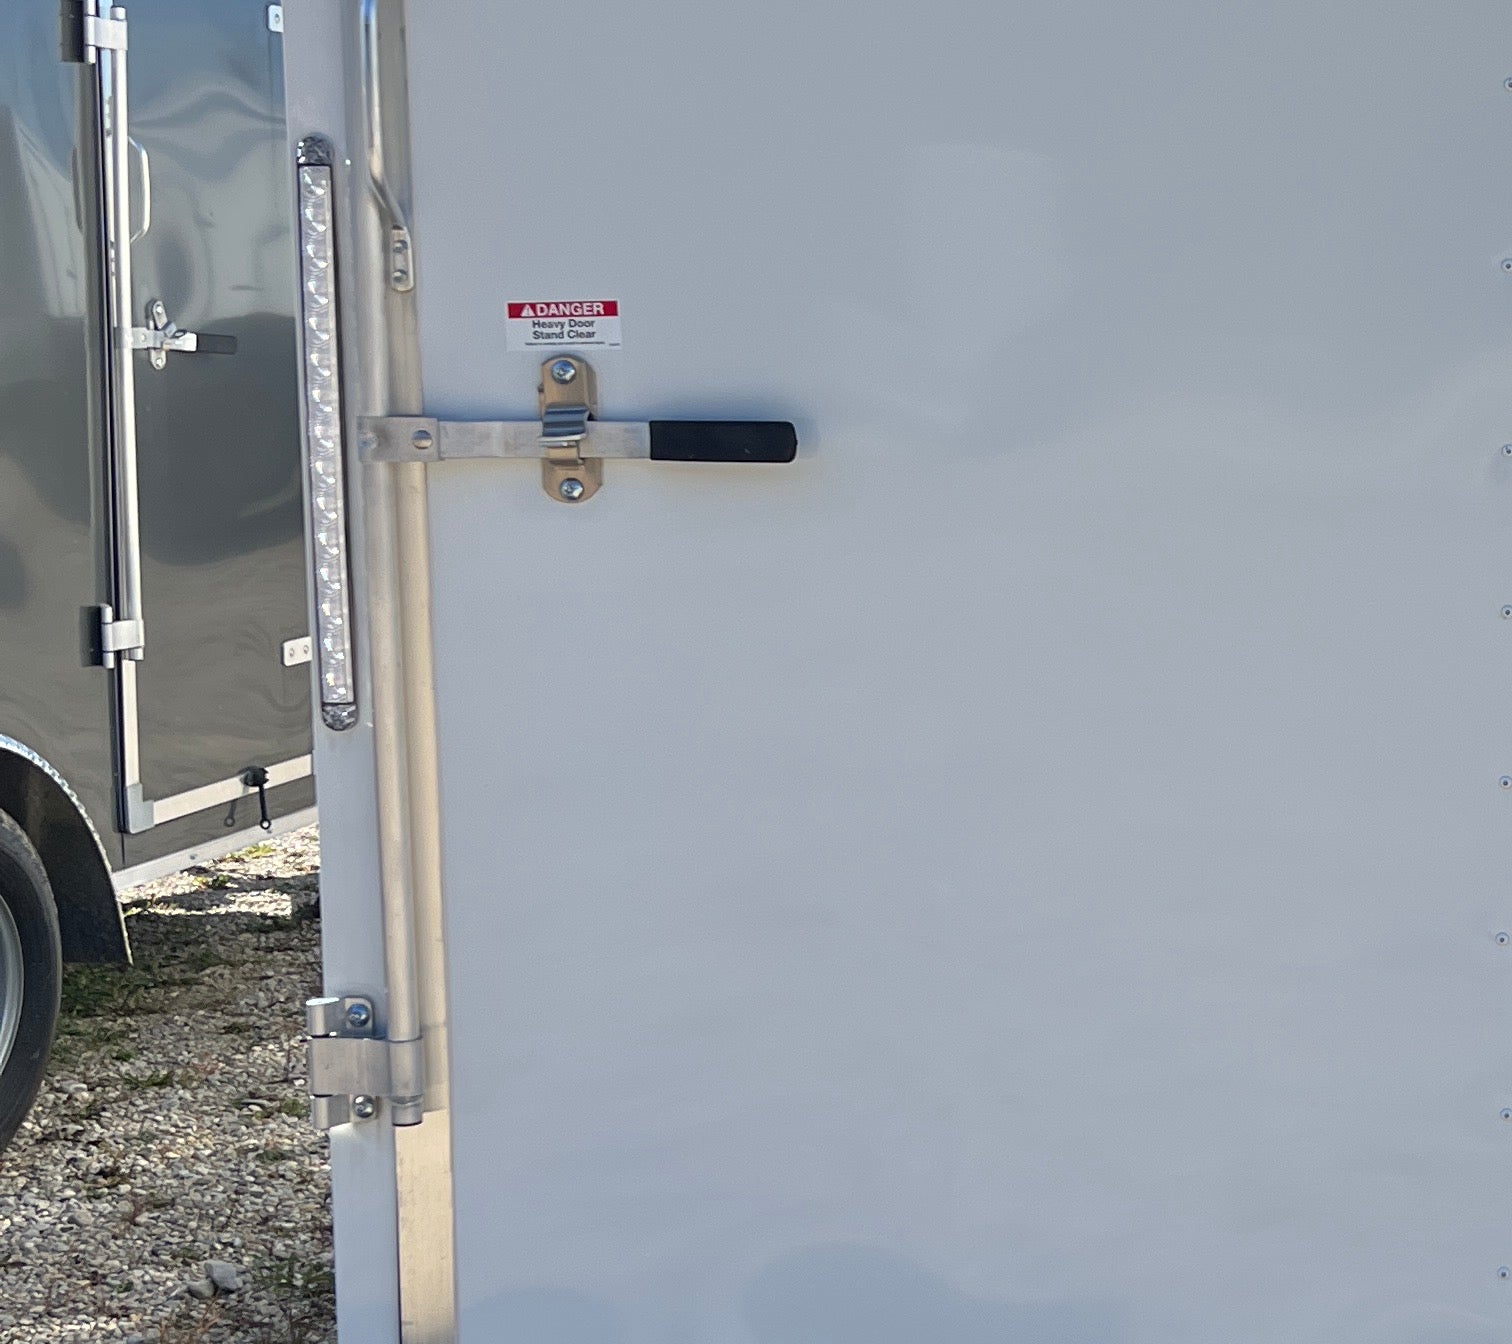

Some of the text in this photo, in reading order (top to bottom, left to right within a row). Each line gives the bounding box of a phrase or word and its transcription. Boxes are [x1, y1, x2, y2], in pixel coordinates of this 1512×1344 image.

[535, 301, 605, 316] DANGER
[532, 318, 596, 330] Heavy Door
[532, 329, 597, 340] Stand Clear
